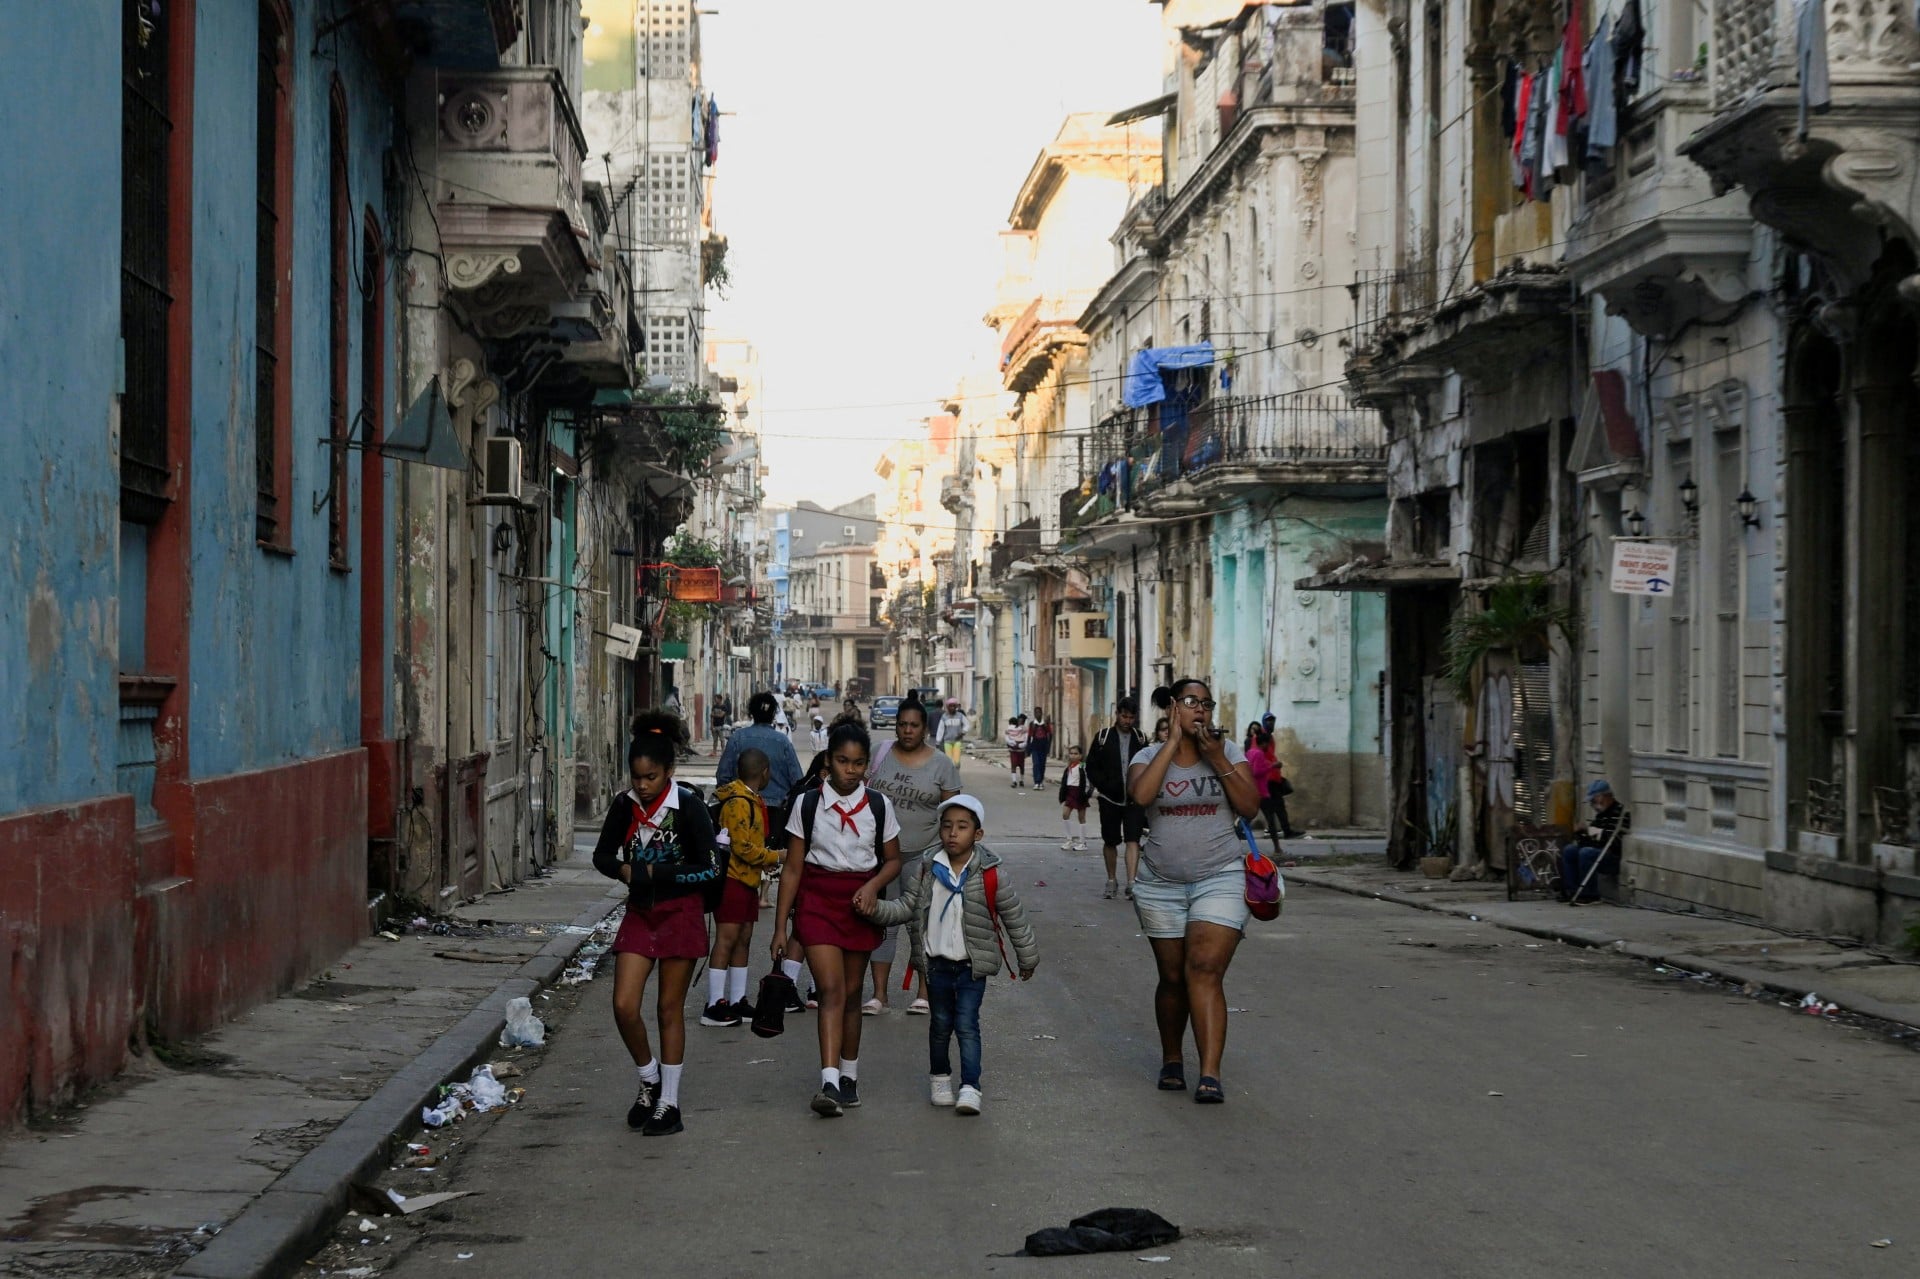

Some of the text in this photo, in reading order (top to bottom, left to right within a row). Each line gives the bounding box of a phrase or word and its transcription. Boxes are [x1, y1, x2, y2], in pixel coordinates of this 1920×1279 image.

[873, 778, 933, 803] ARCASTIC?
[1158, 804, 1218, 816] FASHION
[675, 869, 715, 883] ROXY
